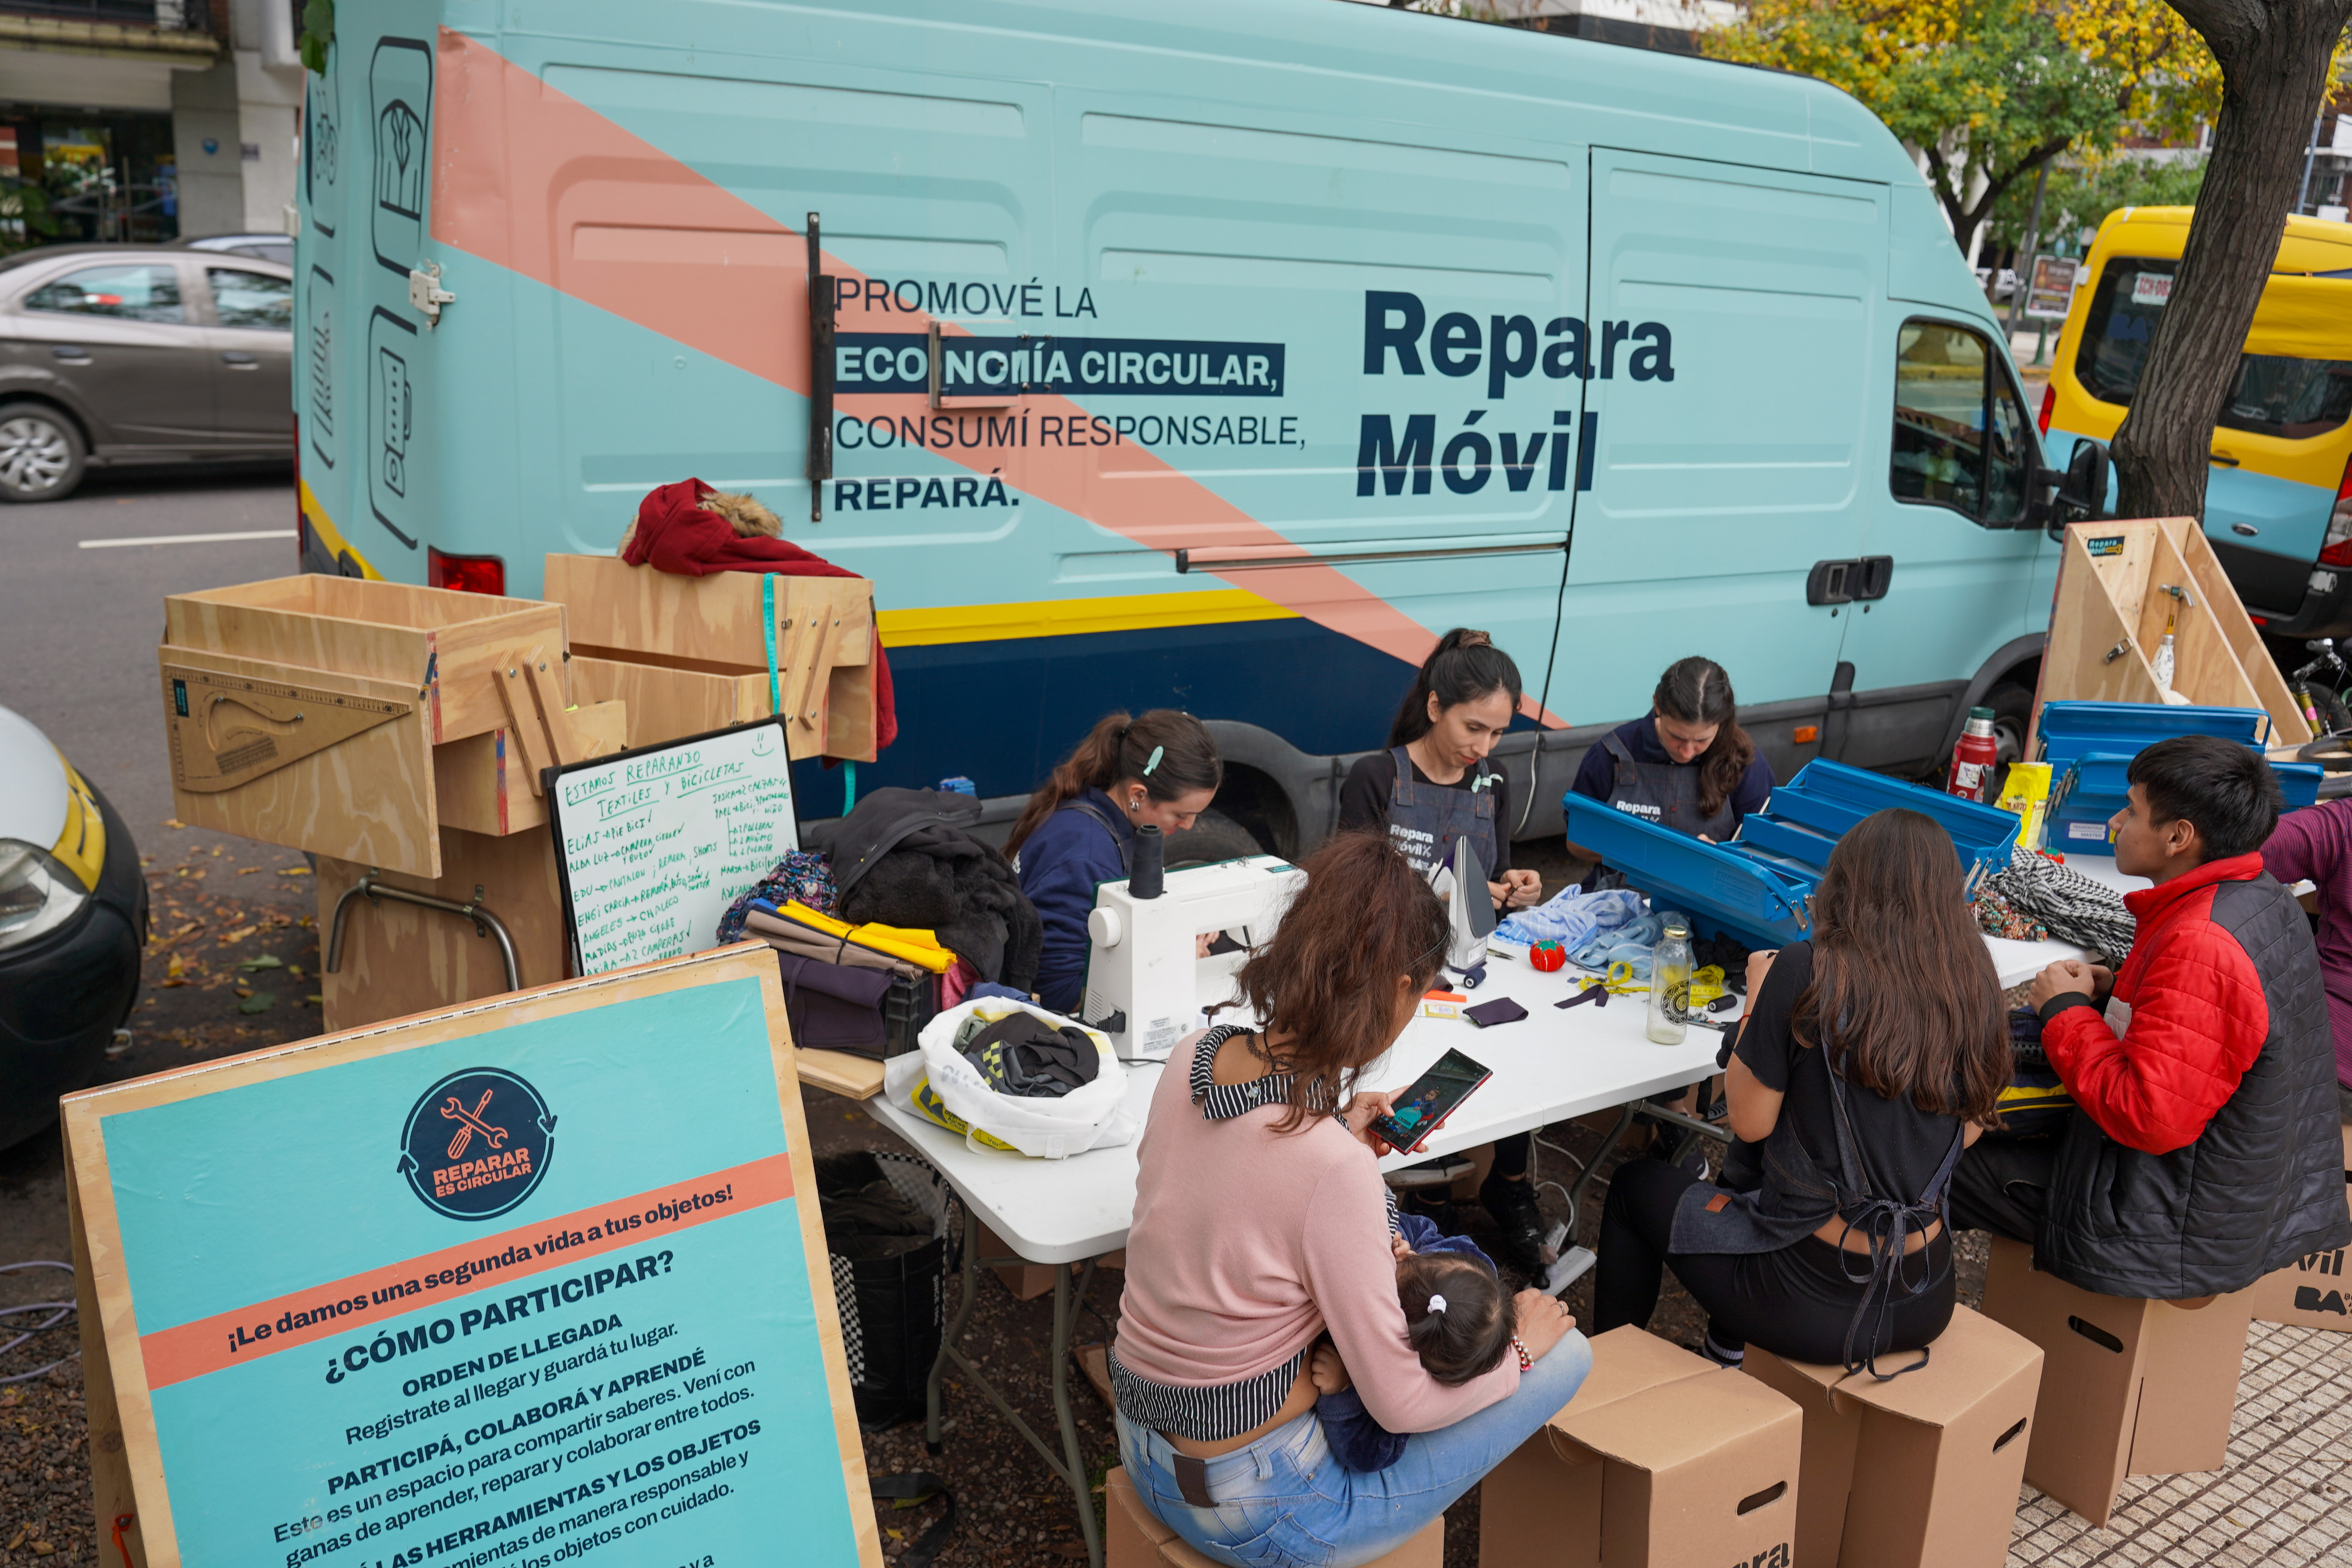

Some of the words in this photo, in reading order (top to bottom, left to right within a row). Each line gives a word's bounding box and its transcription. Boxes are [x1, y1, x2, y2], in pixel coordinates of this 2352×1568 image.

[837, 277, 1043, 318] PROMOVÉ
[1056, 287, 1098, 319] LA
[1080, 350, 1277, 392] CIRCULAR,
[1363, 290, 1675, 399] Repara
[836, 408, 1030, 449] CONSUMÍ
[1040, 415, 1306, 451] RESPONSABLE,
[1356, 409, 1599, 497] Móvil
[835, 468, 1020, 512] REPARÁ.
[566, 771, 615, 806] ESTAMOS
[627, 751, 700, 782] REPARANDO
[1616, 800, 1661, 815] Repara
[1390, 824, 1434, 844] Repara
[574, 884, 593, 902] EDU
[433, 1147, 530, 1186] REPARAR
[435, 1184, 455, 1198] ES
[457, 1162, 532, 1193] CIRCULAR
[228, 1324, 272, 1353] ¡Le
[275, 1295, 369, 1334] damos
[372, 1280, 422, 1305] una
[424, 1246, 532, 1289] segunda
[534, 1230, 585, 1256] vida
[587, 1227, 603, 1241] a
[604, 1215, 642, 1235] tus
[645, 1184, 733, 1223] objetos!
[2297, 1249, 2344, 1276] vil
[326, 1319, 455, 1384] ¿CÓMO
[460, 1250, 673, 1336] PARTICIPAR?
[402, 1357, 485, 1396] ORDEN
[488, 1346, 519, 1370] DE
[521, 1314, 623, 1359] LLEGADA
[327, 1438, 462, 1495] PARTICIPÁ,
[464, 1391, 589, 1446] COLABORÁ
[589, 1384, 604, 1401] Y
[608, 1350, 706, 1397] APRENDÉ
[345, 1399, 451, 1445] Registrate
[454, 1388, 471, 1408] al
[473, 1373, 526, 1401] llegar
[529, 1368, 540, 1386] y
[544, 1346, 609, 1382] guardá
[610, 1340, 628, 1355] tu
[630, 1323, 678, 1349] lugar.
[274, 1514, 324, 1544] Este
[327, 1504, 353, 1524] es
[356, 1494, 382, 1513] un
[385, 1465, 464, 1502] espacio
[468, 1448, 512, 1477] para
[514, 1414, 602, 1455] compartir
[605, 1389, 681, 1423] saberes.
[683, 1373, 721, 1394] Vení
[724, 1361, 755, 1380] con
[286, 1533, 352, 1568] ganas
[355, 1522, 382, 1541] de
[385, 1487, 479, 1530] aprender,
[482, 1459, 550, 1495] reparar
[552, 1454, 563, 1473] y
[566, 1422, 651, 1463] colaborar
[654, 1407, 699, 1431] entre
[701, 1388, 755, 1414] todos.
[425, 1478, 605, 1558] HERRAMIENTAS
[606, 1471, 620, 1488] Y
[623, 1456, 665, 1483] LOS
[667, 1420, 761, 1465] OBJETOS
[448, 1536, 529, 1568] mientas
[532, 1526, 556, 1544] de
[559, 1499, 629, 1534] manera
[630, 1456, 736, 1506] responsable
[739, 1451, 748, 1468] y
[554, 1527, 622, 1561] objetos
[624, 1512, 658, 1533] con
[660, 1483, 734, 1520] cuidado.
